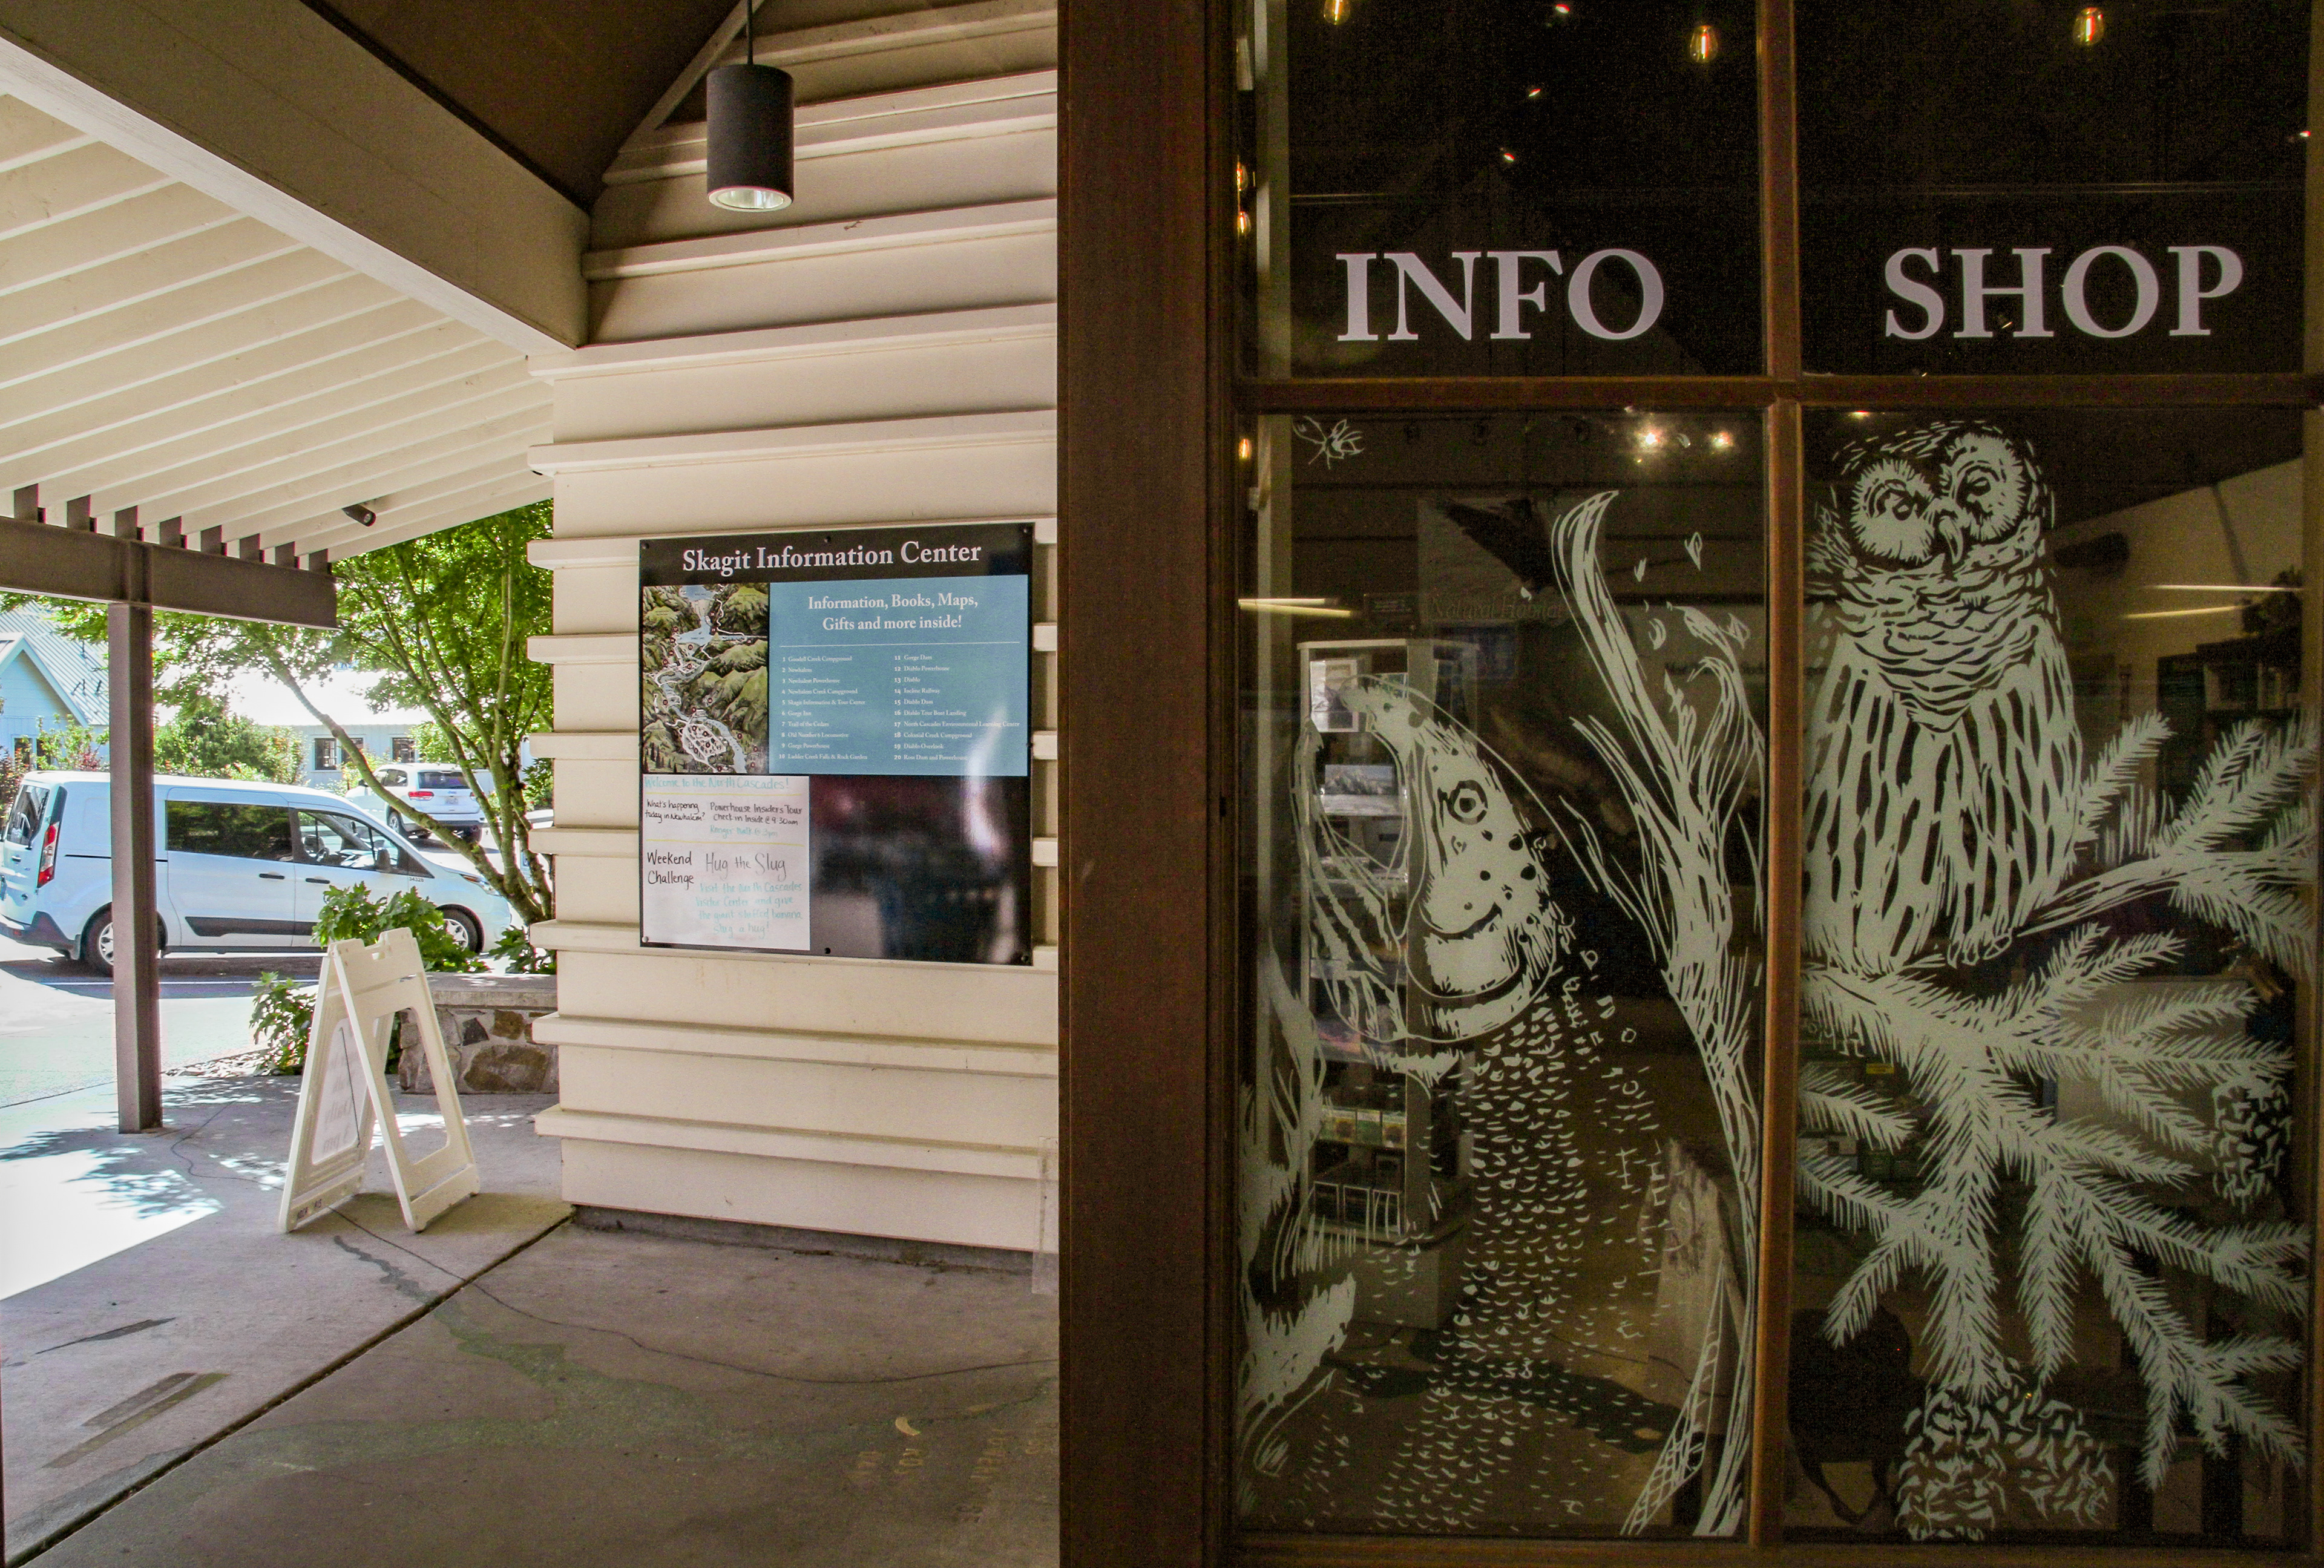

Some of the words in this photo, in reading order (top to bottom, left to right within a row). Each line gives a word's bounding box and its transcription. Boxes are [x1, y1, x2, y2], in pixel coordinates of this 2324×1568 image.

[1336, 248, 1664, 341] INFO
[1885, 245, 2243, 340] SHOP
[683, 549, 751, 577] Skagit
[757, 546, 893, 569] Information
[901, 540, 982, 563] Center
[809, 596, 888, 610] Information,
[891, 593, 935, 609] Books,
[938, 592, 978, 609] Maps,
[822, 617, 855, 630] Gifts
[858, 616, 881, 629] and
[884, 619, 917, 629] more
[919, 615, 962, 628] inside!
[645, 778, 681, 787] Welcome
[682, 778, 690, 787] to
[692, 778, 707, 787] the
[709, 778, 735, 787] North
[737, 778, 789, 789] Cascades!
[647, 799, 666, 808] What's
[710, 802, 750, 812] Powerhouse
[754, 804, 784, 814] Insiders
[785, 804, 802, 815] Tour
[645, 812, 663, 823] today
[745, 815, 764, 824] Inside
[647, 850, 692, 865] Weekend
[706, 853, 728, 880] Hug
[735, 856, 751, 869] the
[755, 853, 786, 882] Slug
[648, 870, 694, 890] Challenge
[722, 883, 735, 893] the
[764, 881, 802, 893] Cascades
[775, 896, 793, 908] give
[698, 911, 710, 920] the
